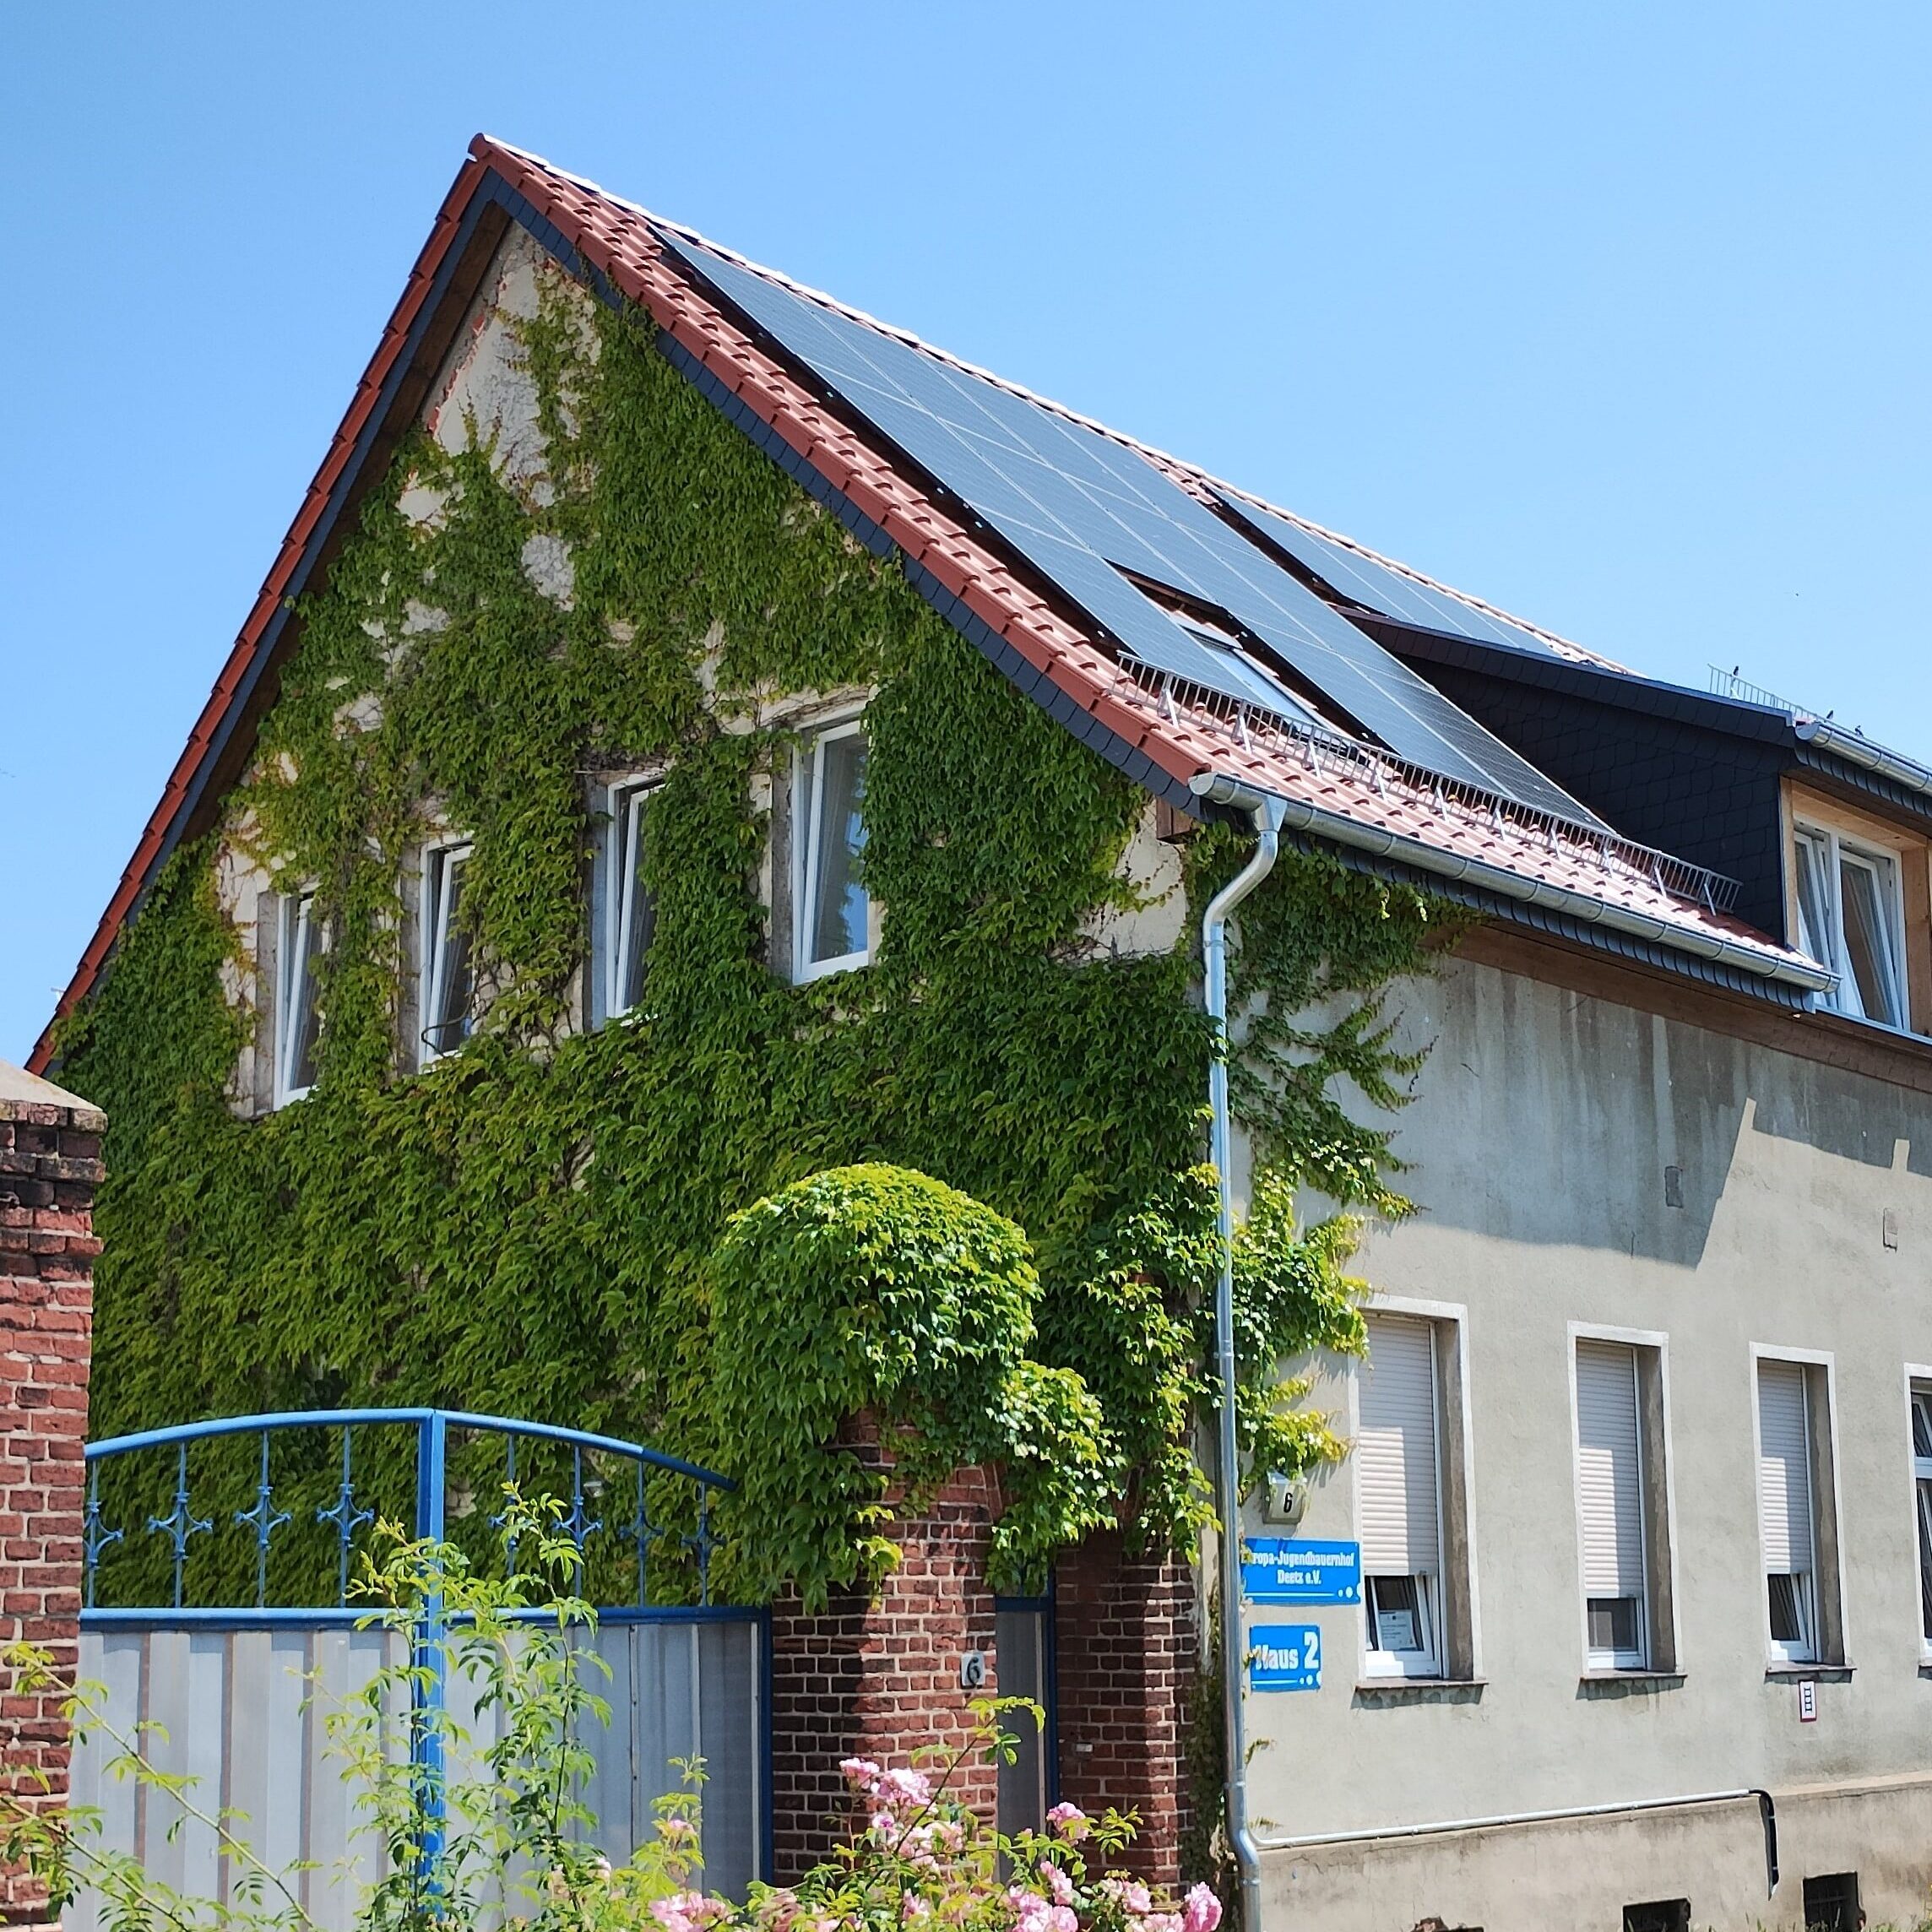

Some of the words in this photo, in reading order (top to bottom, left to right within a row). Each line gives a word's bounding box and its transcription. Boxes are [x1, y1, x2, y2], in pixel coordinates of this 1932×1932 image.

[1283, 1492, 1294, 1513] 6
[1241, 1550, 1355, 1568] ropa-Jugendbauernhof
[1305, 1569, 1322, 1585] e.V.
[1304, 1631, 1319, 1669] 2
[967, 1657, 980, 1685] 6
